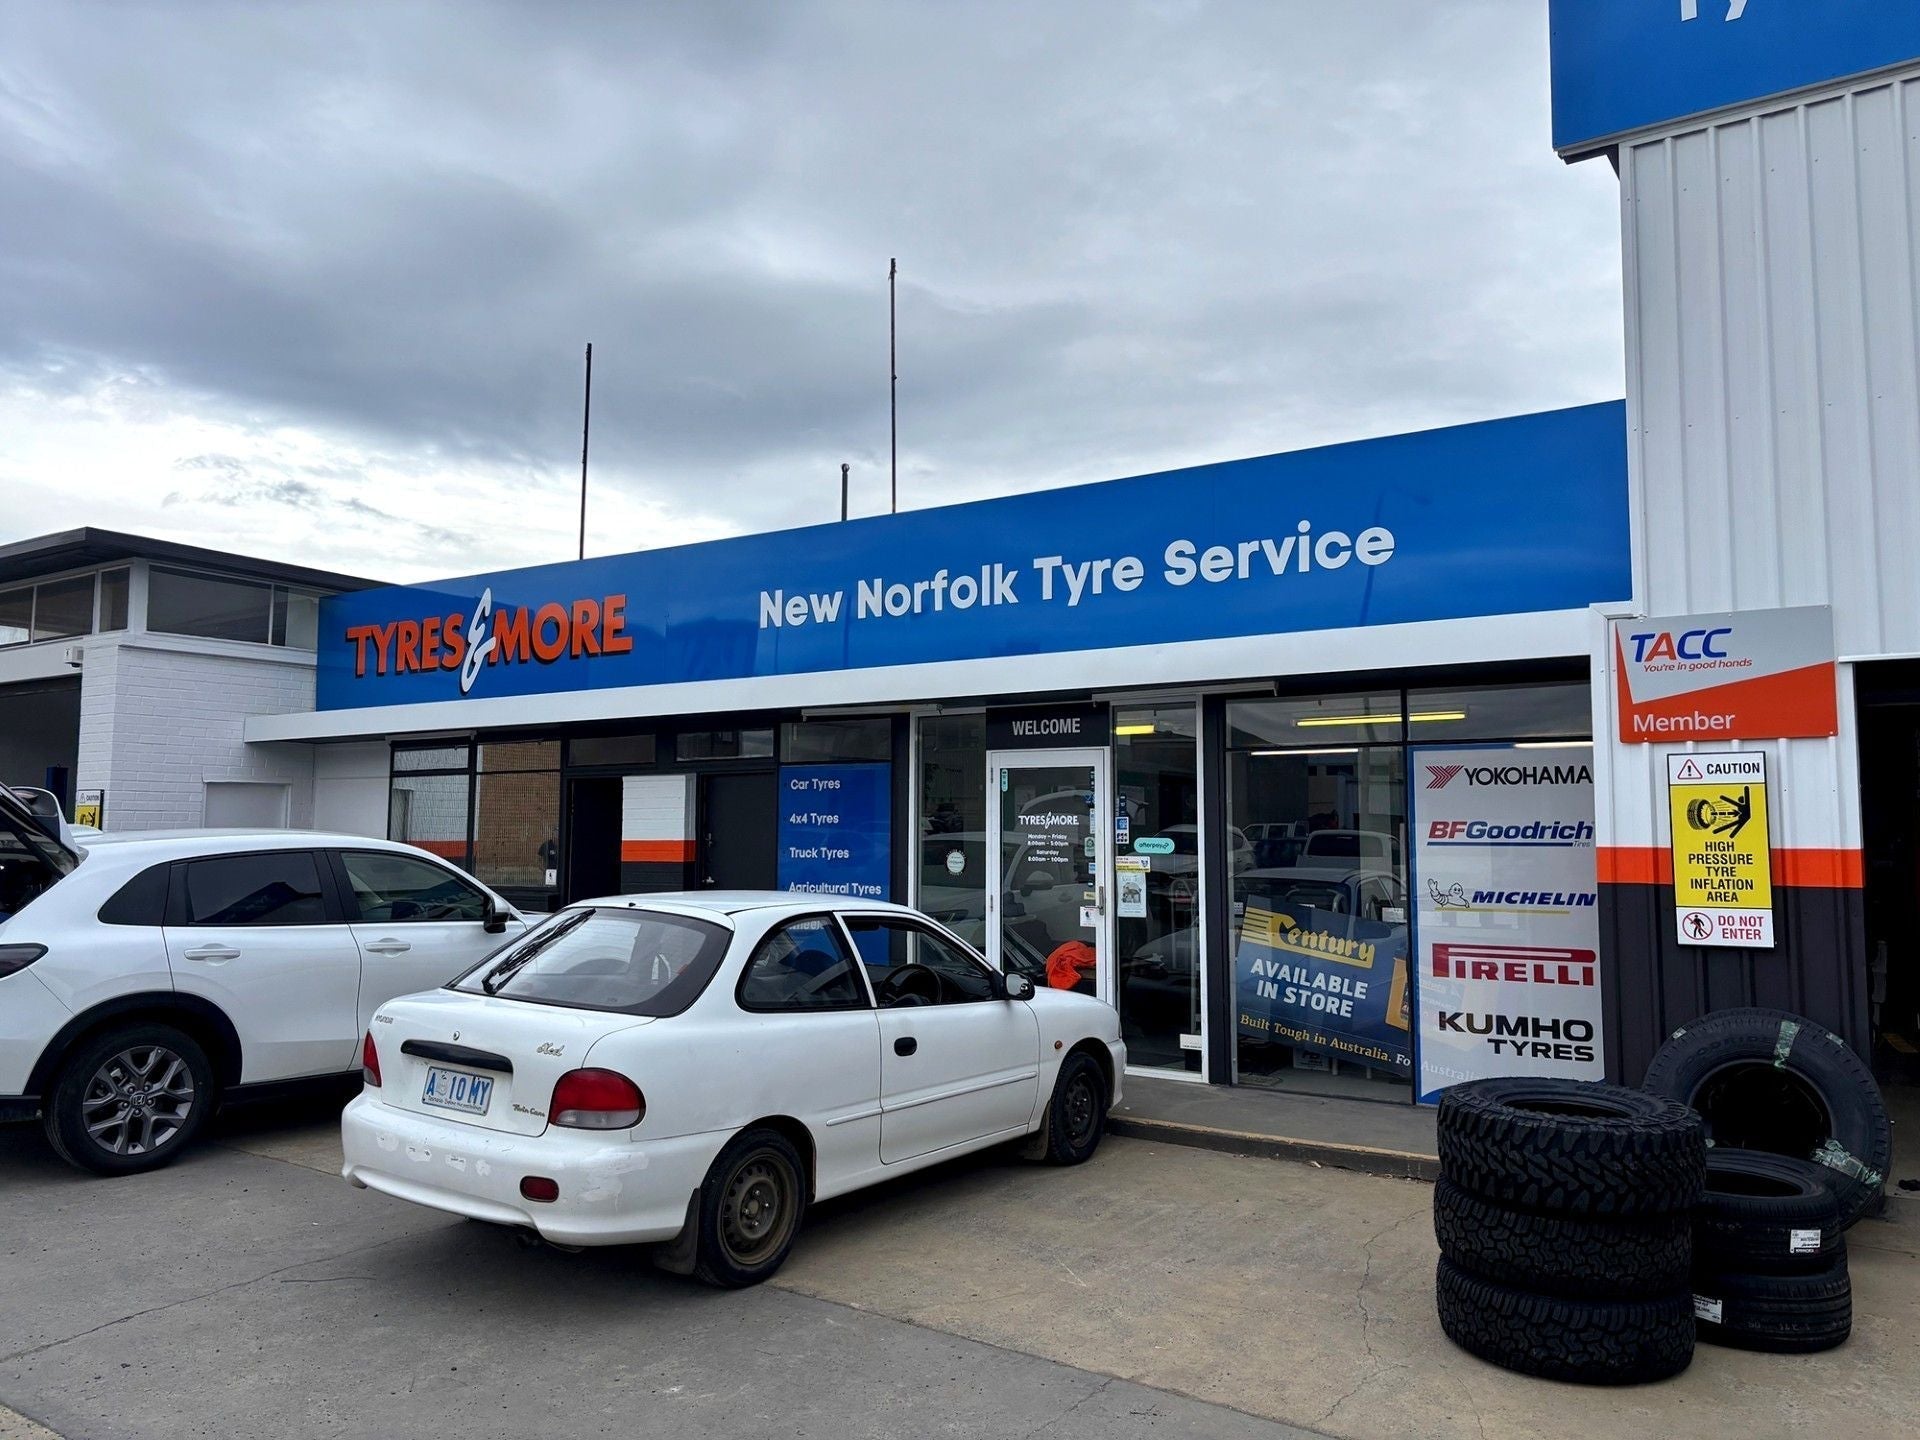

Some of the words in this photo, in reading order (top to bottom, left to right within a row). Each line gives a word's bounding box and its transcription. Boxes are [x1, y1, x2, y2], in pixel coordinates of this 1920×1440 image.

[759, 589, 844, 629] New
[857, 563, 1019, 619] Norfolk
[1033, 555, 1145, 607] Tyre
[1164, 520, 1395, 586] Service
[1630, 628, 1732, 663] TACC
[1644, 663, 1675, 673] You're
[1677, 662, 1687, 670] in
[1688, 660, 1717, 672] good
[1718, 658, 1753, 668] hands
[1012, 718, 1080, 736] WELCOME
[1633, 711, 1735, 732] Member
[1464, 765, 1593, 786] YOKOHAMA
[1706, 763, 1760, 775] CAUTION
[790, 779, 809, 790] Car
[812, 779, 841, 792] Tyres
[789, 813, 808, 824] 4x4
[810, 813, 839, 826] Tyres
[1428, 820, 1594, 840] BFGoodrich
[789, 847, 818, 859] Truck
[820, 847, 850, 861] Tyres
[1705, 841, 1735, 852] HIGH
[1688, 854, 1753, 865] PRESSURE
[1705, 866, 1736, 877] TYRE
[789, 882, 849, 894] Agricultural
[851, 883, 882, 896] Tyres
[1690, 878, 1754, 890] INFLATION
[1471, 891, 1597, 907] MICHELIN
[1706, 891, 1739, 902] AREA
[1718, 915, 1735, 927] DO
[1739, 916, 1764, 928] NOT
[1268, 910, 1376, 969] Century
[1722, 928, 1762, 940] ENTER
[1432, 943, 1596, 987] PIRELLI
[1250, 958, 1369, 1000] AVAILABLE
[1256, 979, 1278, 1000] IN
[1283, 986, 1354, 1018] STORE
[1438, 1010, 1594, 1042] KUMHO
[1239, 1013, 1270, 1031] Built
[1274, 1022, 1310, 1042] Tough
[1313, 1032, 1327, 1046] in
[1329, 1037, 1392, 1062] Australia.
[1487, 1038, 1595, 1062] TYRES
[426, 1072, 436, 1096] A
[449, 1076, 467, 1101] 10
[468, 1079, 491, 1106] MY
